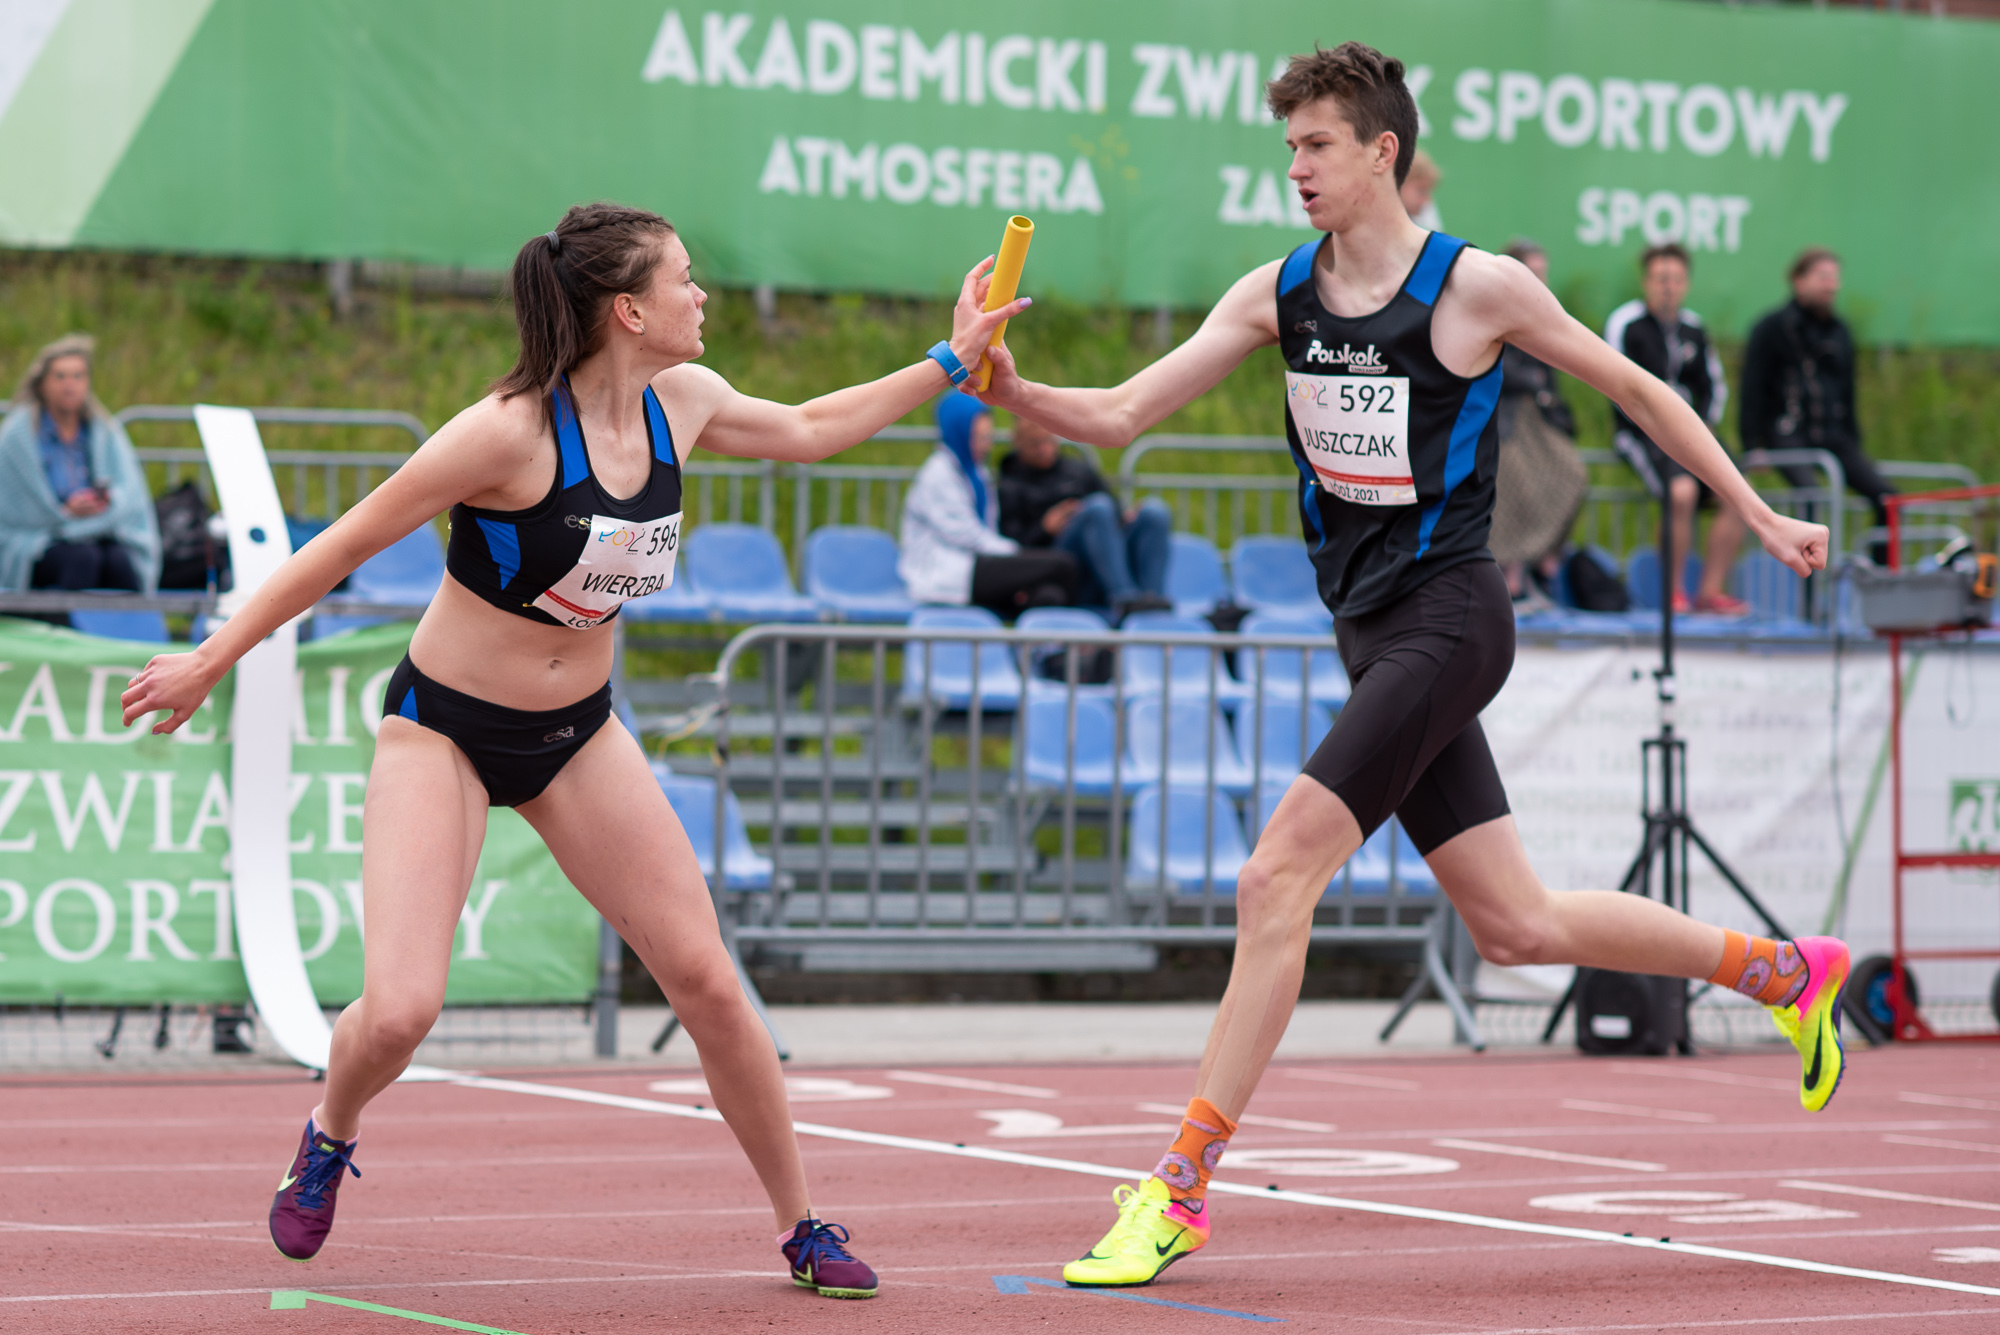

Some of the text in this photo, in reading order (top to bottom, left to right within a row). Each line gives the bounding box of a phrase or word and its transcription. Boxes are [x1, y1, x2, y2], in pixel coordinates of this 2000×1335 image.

[643, 9, 1104, 113] AKADEMICKI
[1453, 69, 1847, 162] SPORTOWY
[759, 135, 1102, 213] ATMOSFERA
[1578, 188, 1750, 252] SPORT
[1340, 384, 1395, 413] 592
[1304, 427, 1397, 457] JUSZCZAK
[1353, 487, 1380, 502] 2021
[646, 521, 678, 556] 596
[581, 572, 665, 597] WIERZBA
